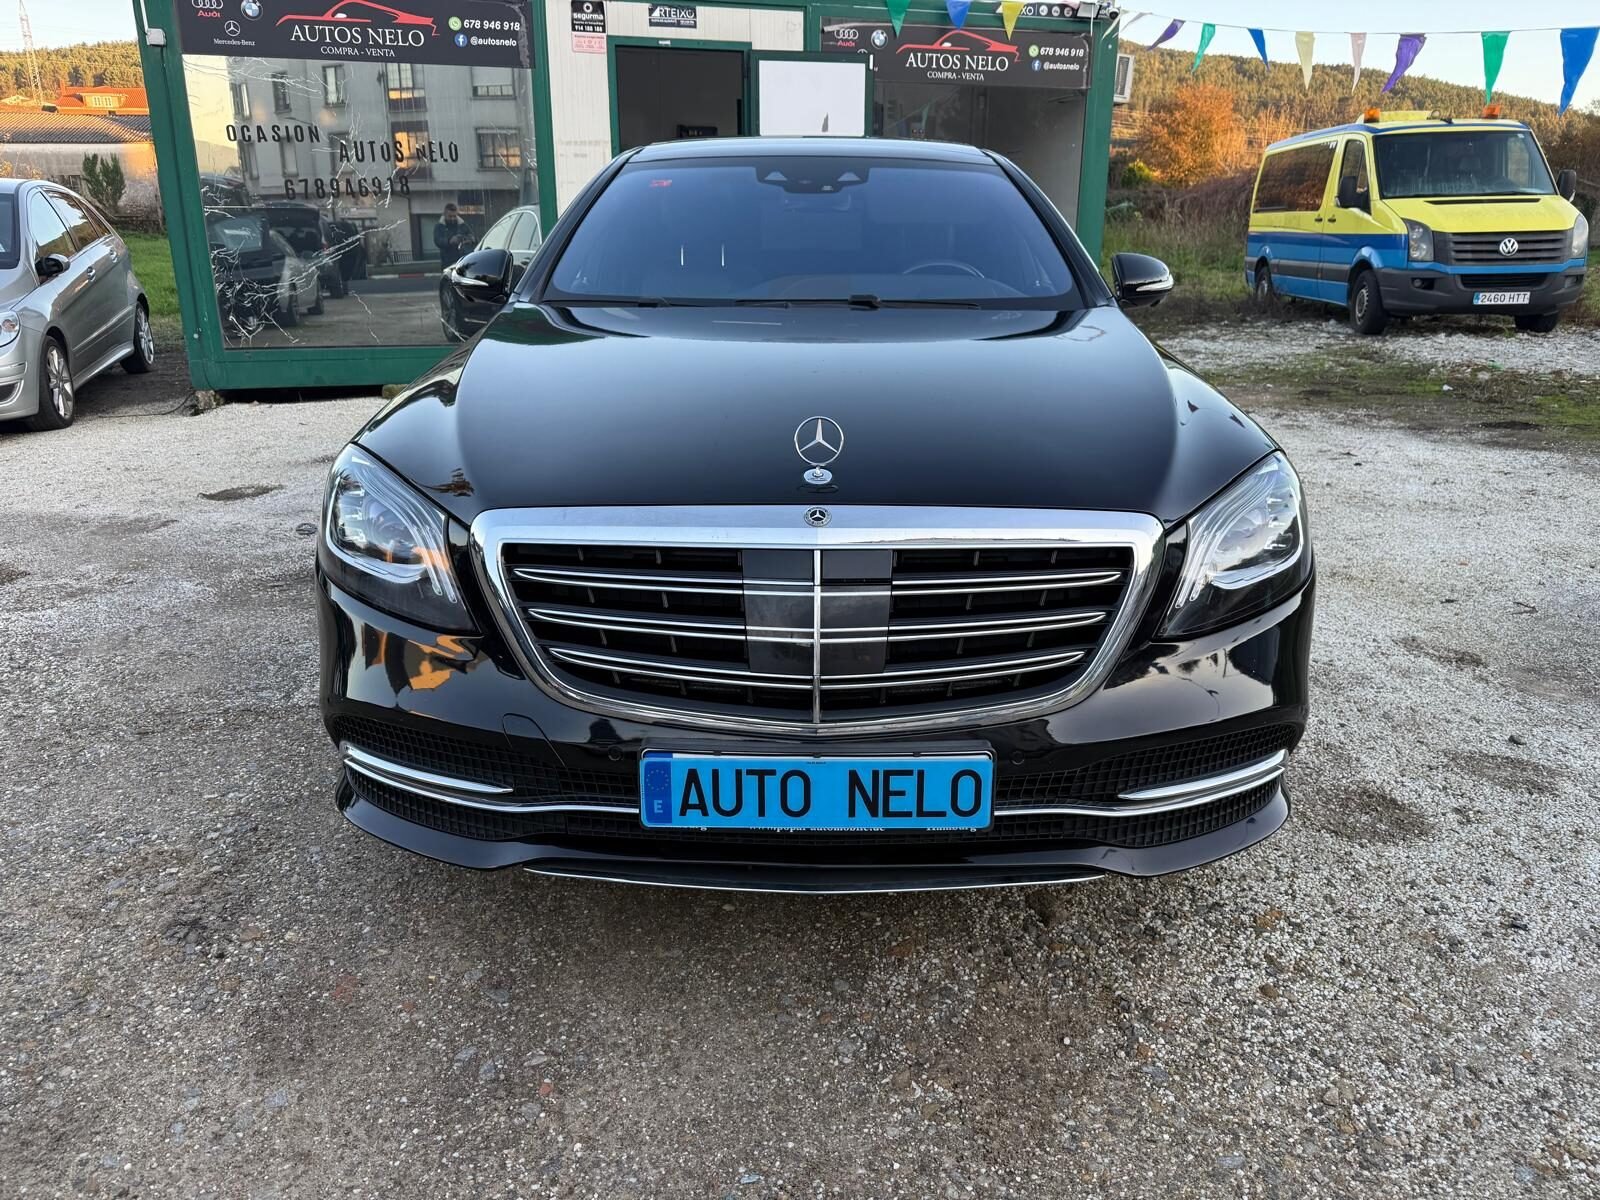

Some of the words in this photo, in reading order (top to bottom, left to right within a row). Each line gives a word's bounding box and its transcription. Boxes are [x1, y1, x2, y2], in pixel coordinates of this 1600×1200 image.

[573, 12, 604, 20] segurma
[463, 19, 482, 29] 678
[483, 20, 501, 30] 946
[503, 21, 521, 31] 918
[290, 24, 362, 44] AUTOS
[368, 28, 425, 47] NELO
[213, 38, 256, 46] Mercedes-Benz
[470, 36, 517, 47] @autosnelo
[320, 46, 360, 56] COMPRA
[365, 48, 396, 57] VENTA
[1040, 47, 1055, 56] 678
[1055, 48, 1069, 56] 946
[1070, 48, 1085, 57] 918
[905, 52, 961, 70] AUTOS
[965, 55, 1009, 72] NELO
[1043, 61, 1080, 71] @autosnelo
[927, 70, 957, 80] COMPRA
[962, 73, 984, 81] VENTA
[226, 124, 321, 143] OCASION
[339, 140, 405, 163] AUTOS
[415, 141, 460, 163] NELO
[284, 175, 410, 200] 678946918
[1481, 293, 1506, 303] 2460
[1508, 293, 1528, 303] HTT
[679, 768, 812, 818] AUTO
[847, 768, 983, 819] NELO
[653, 799, 663, 814] E
